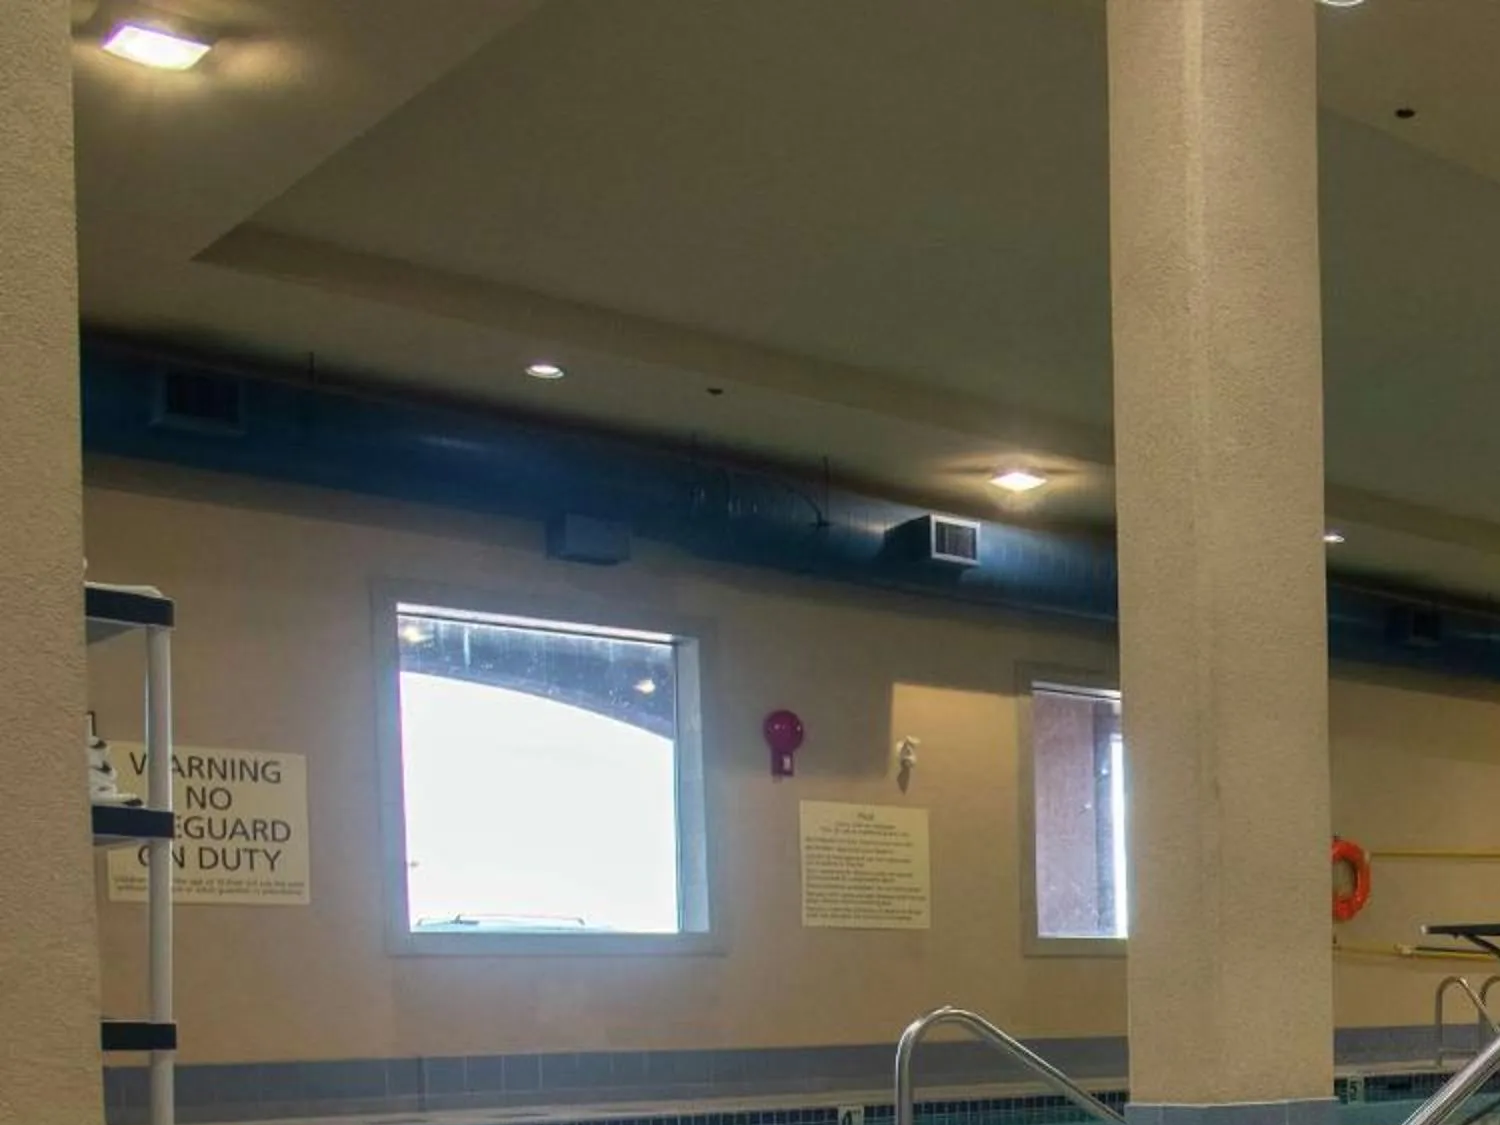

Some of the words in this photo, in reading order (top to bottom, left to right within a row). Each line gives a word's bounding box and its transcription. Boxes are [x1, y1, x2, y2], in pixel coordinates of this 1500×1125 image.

[129, 751, 282, 785] WARNING
[186, 785, 233, 811] NO
[199, 846, 281, 872] DUTY
